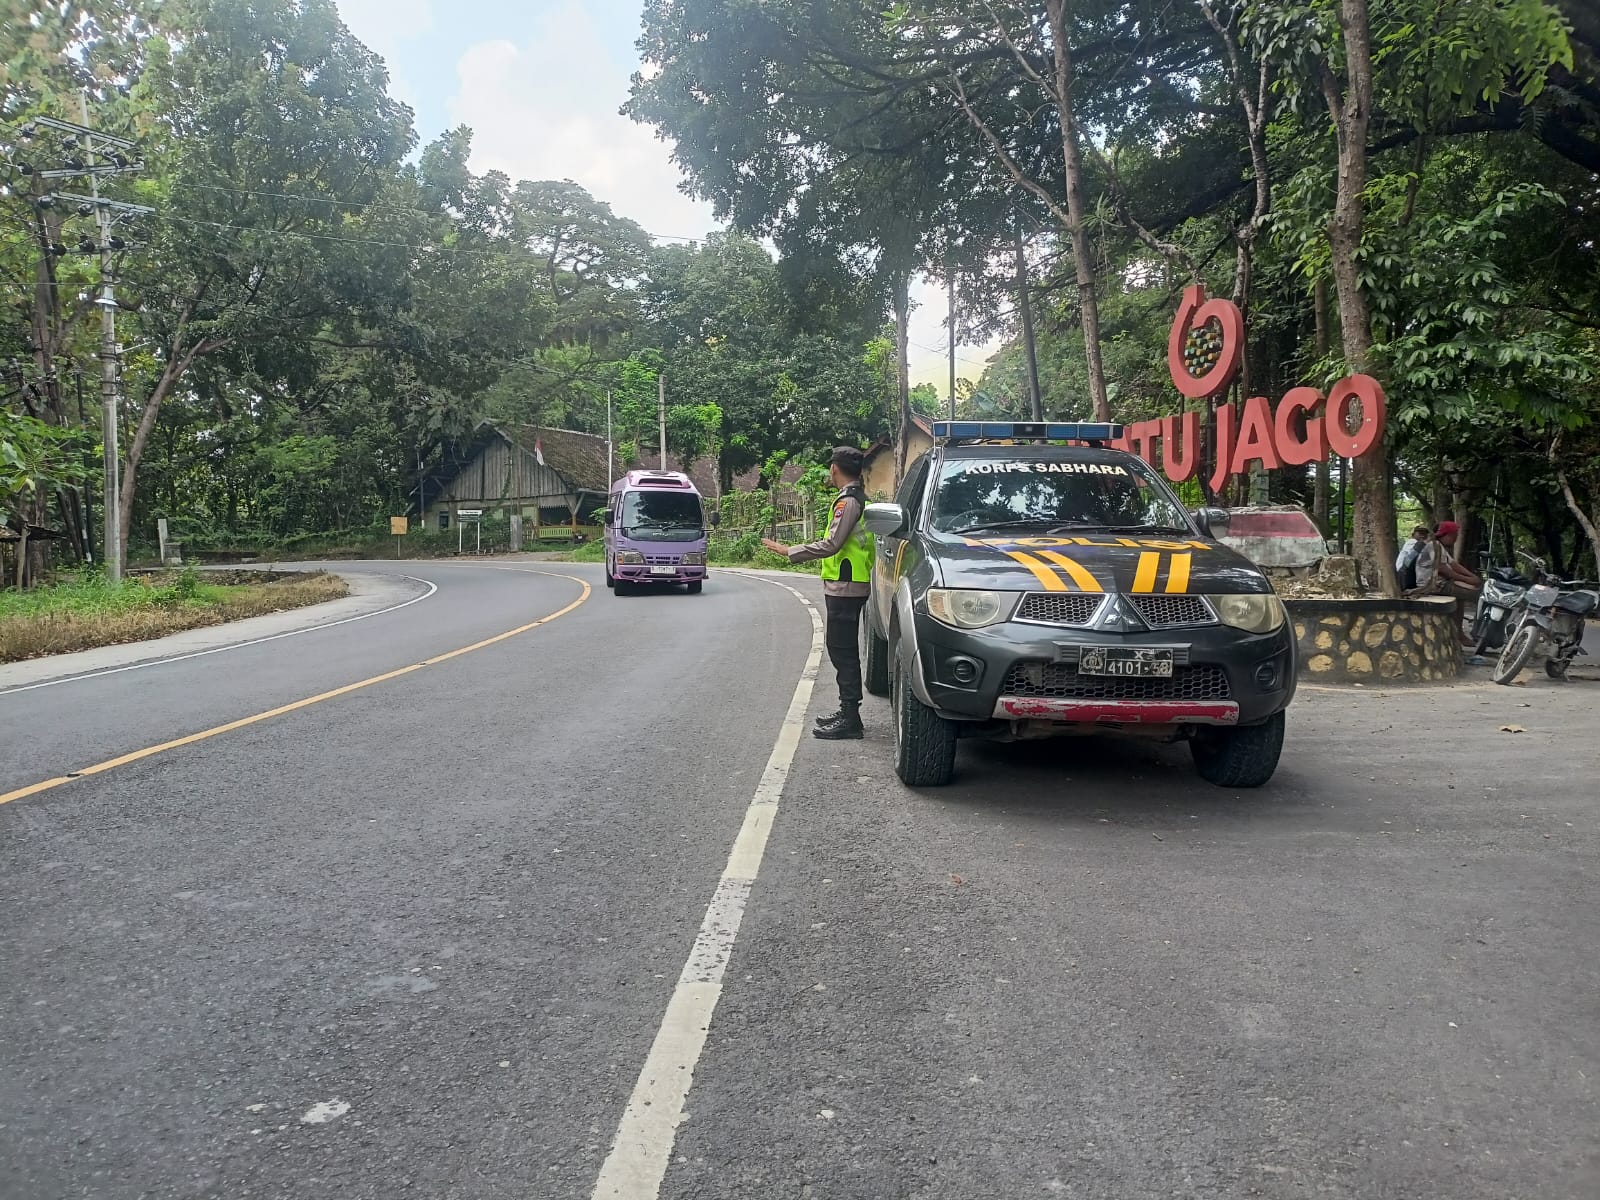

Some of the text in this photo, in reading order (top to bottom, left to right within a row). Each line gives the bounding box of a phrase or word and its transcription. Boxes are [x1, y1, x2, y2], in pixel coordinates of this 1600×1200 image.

[1209, 373, 1386, 494] JAGO
[1035, 462, 1129, 476] SABHARA
[962, 536, 1213, 550] POLISI
